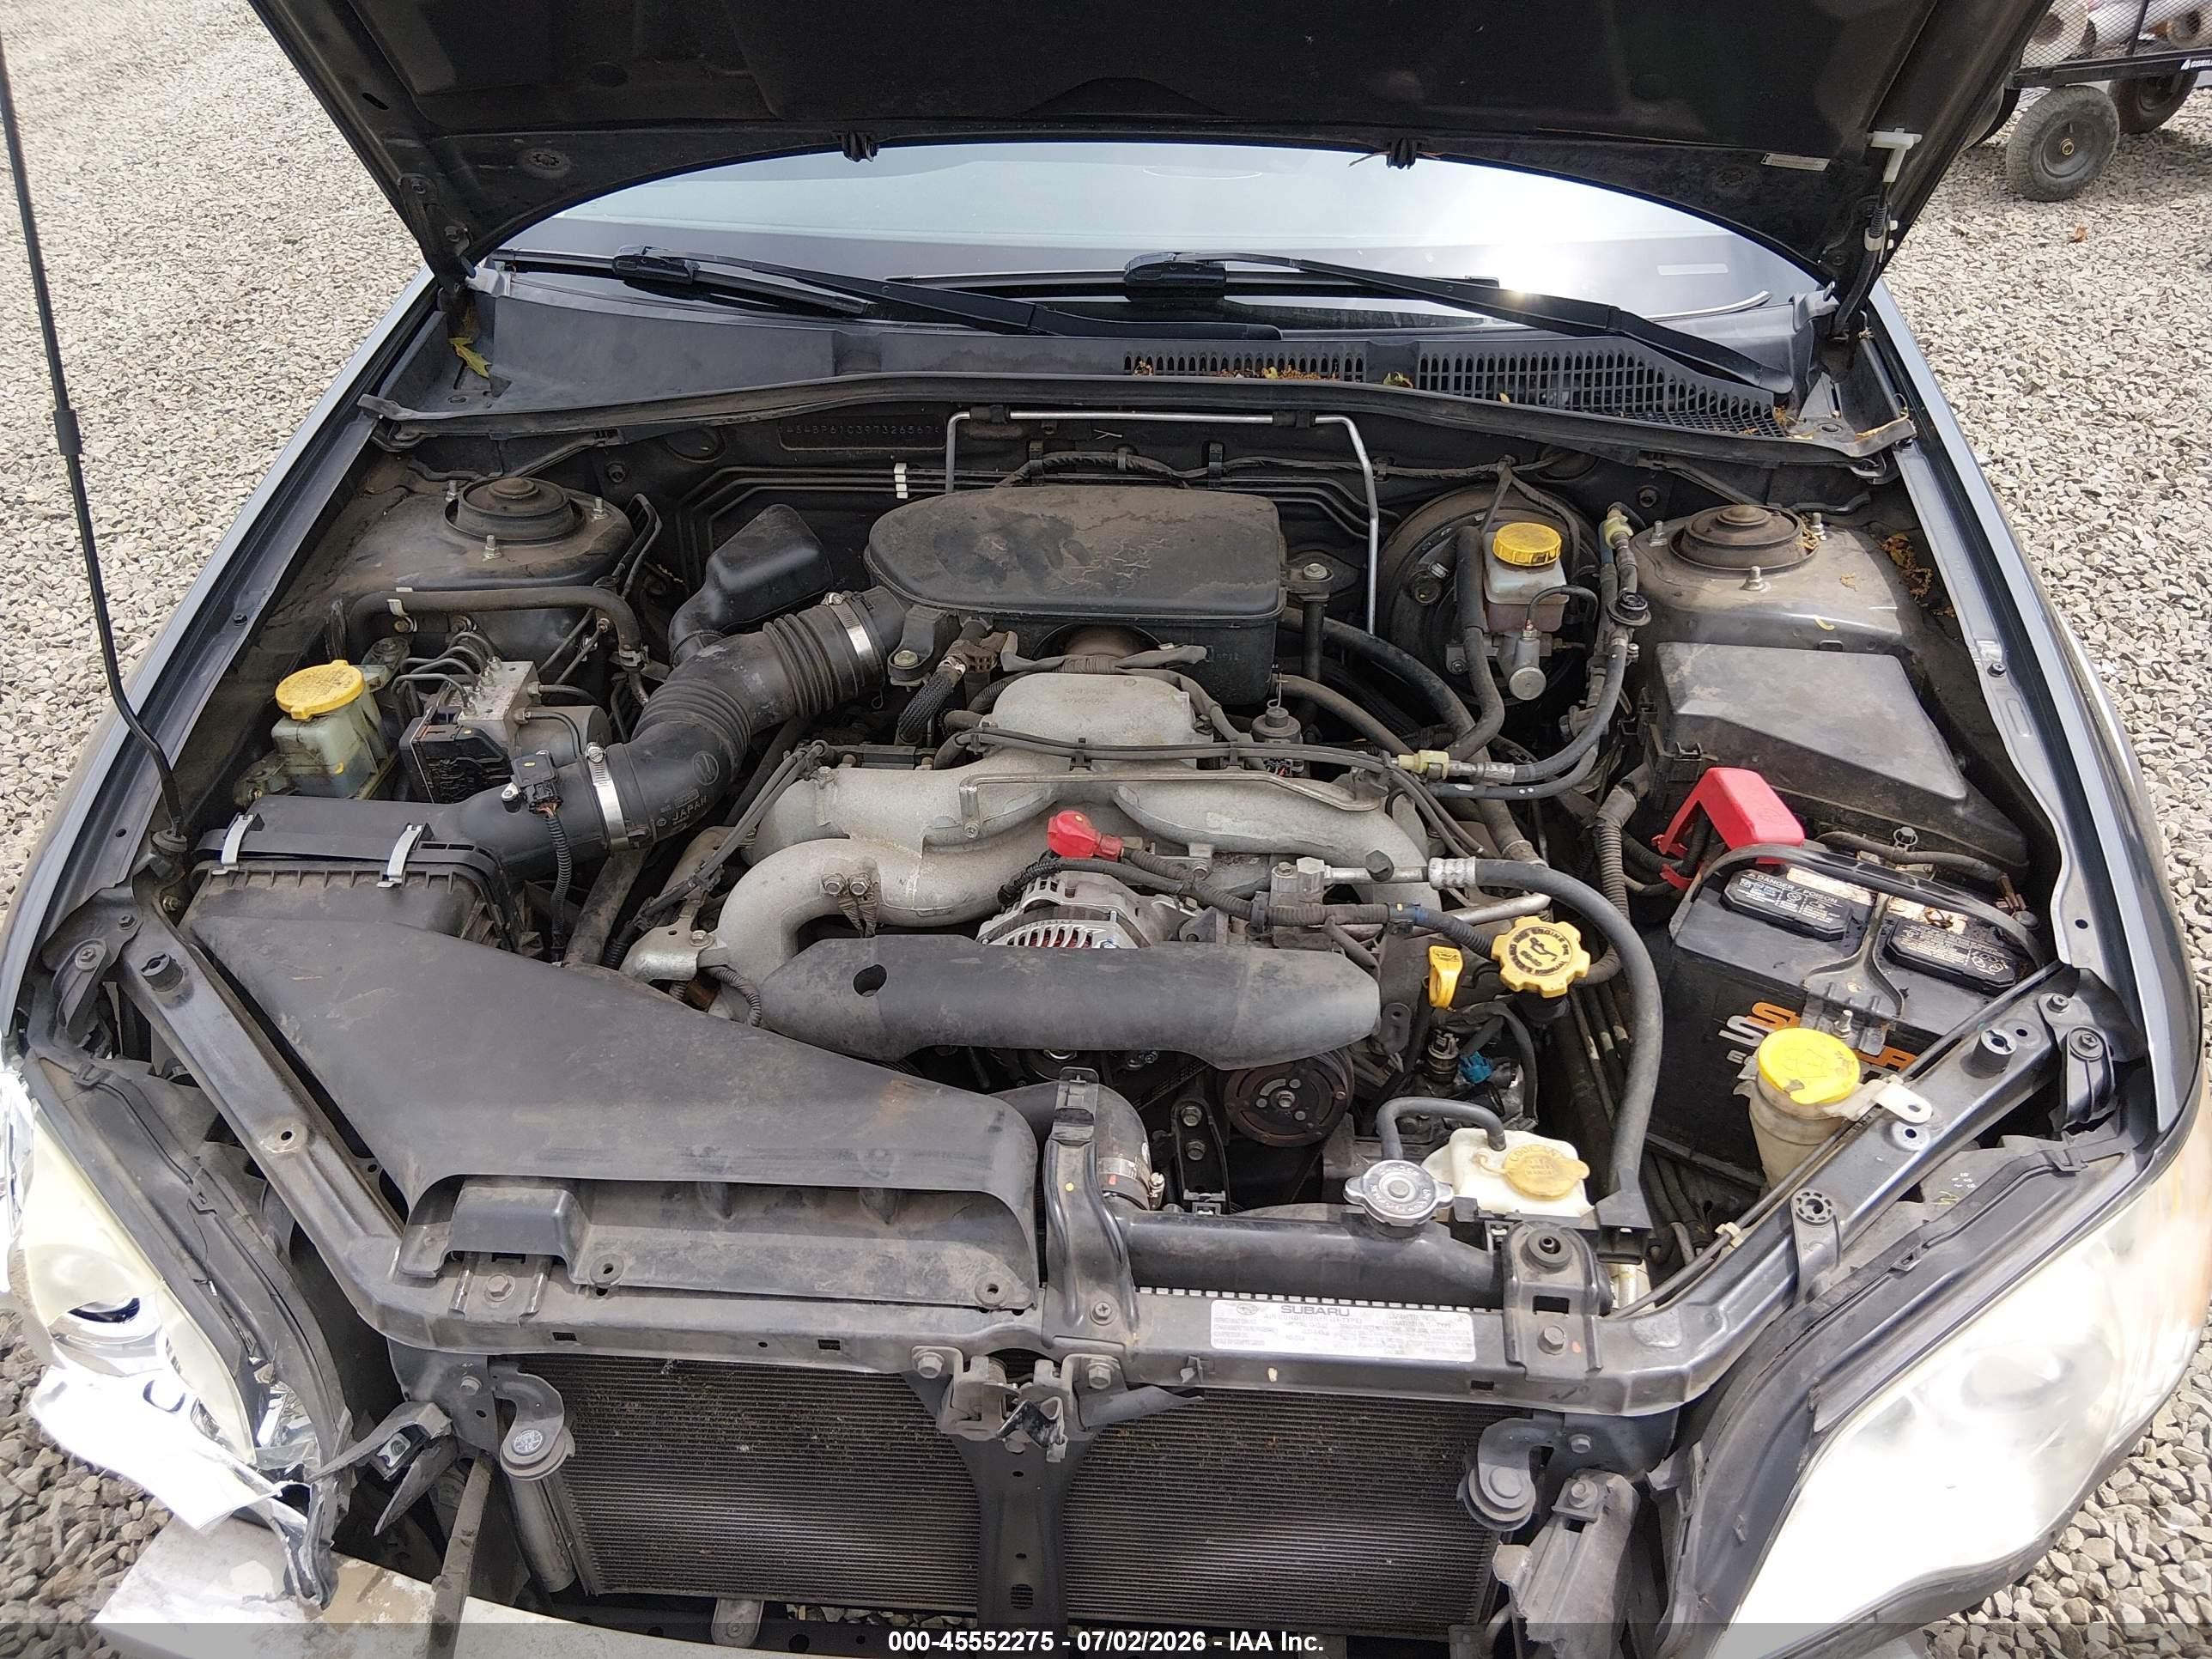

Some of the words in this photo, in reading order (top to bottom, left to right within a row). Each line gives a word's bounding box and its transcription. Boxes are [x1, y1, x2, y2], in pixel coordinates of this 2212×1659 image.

[672, 795, 708, 821] JAPAN
[1757, 874, 1795, 891] DANGER
[1803, 888, 1838, 904] POISON
[1280, 1304, 1350, 1316] SUBARU
